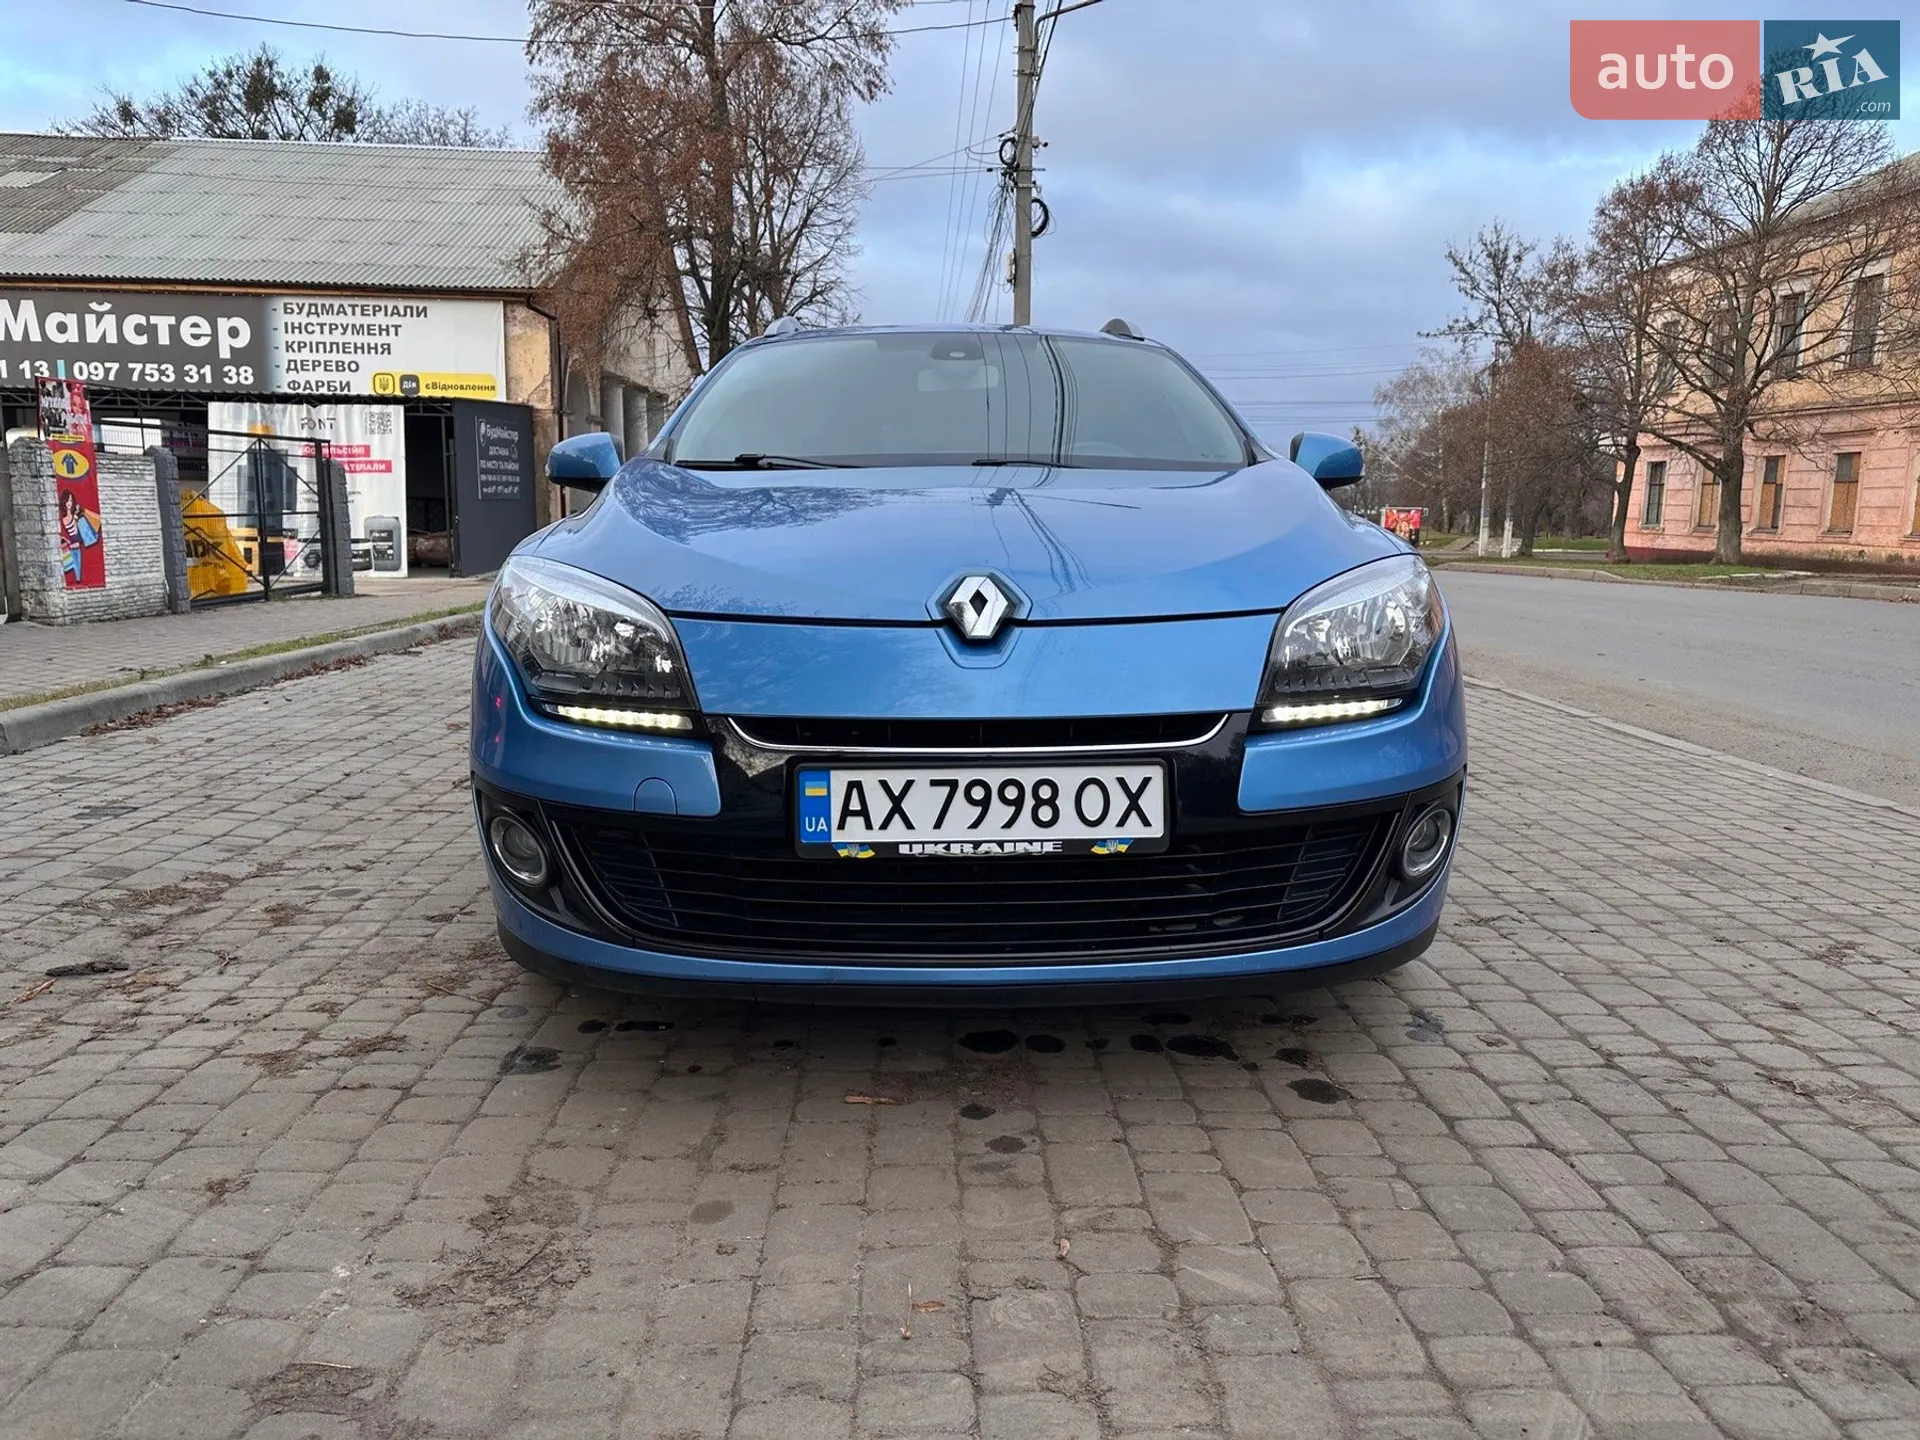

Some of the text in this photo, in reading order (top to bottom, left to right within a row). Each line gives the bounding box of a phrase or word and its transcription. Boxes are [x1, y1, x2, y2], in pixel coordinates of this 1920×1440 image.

[283, 302, 428, 318] БУДМАТЕРІАЛИ
[0, 299, 251, 359] Майстер
[284, 322, 402, 337] ІНСТРУМЕНТ
[285, 341, 392, 355] КРІПЛЕННЯ
[19, 359, 50, 379] 13
[72, 361, 120, 381] 097
[128, 362, 175, 383] 753
[183, 364, 213, 383] 31
[223, 365, 254, 385] 38
[285, 359, 360, 374] ДЕРЕВО
[287, 379, 351, 393] ФАРБИ
[929, 778, 1060, 830] 7998
[805, 816, 828, 833] UA
[898, 840, 1064, 855] UKRAINE
